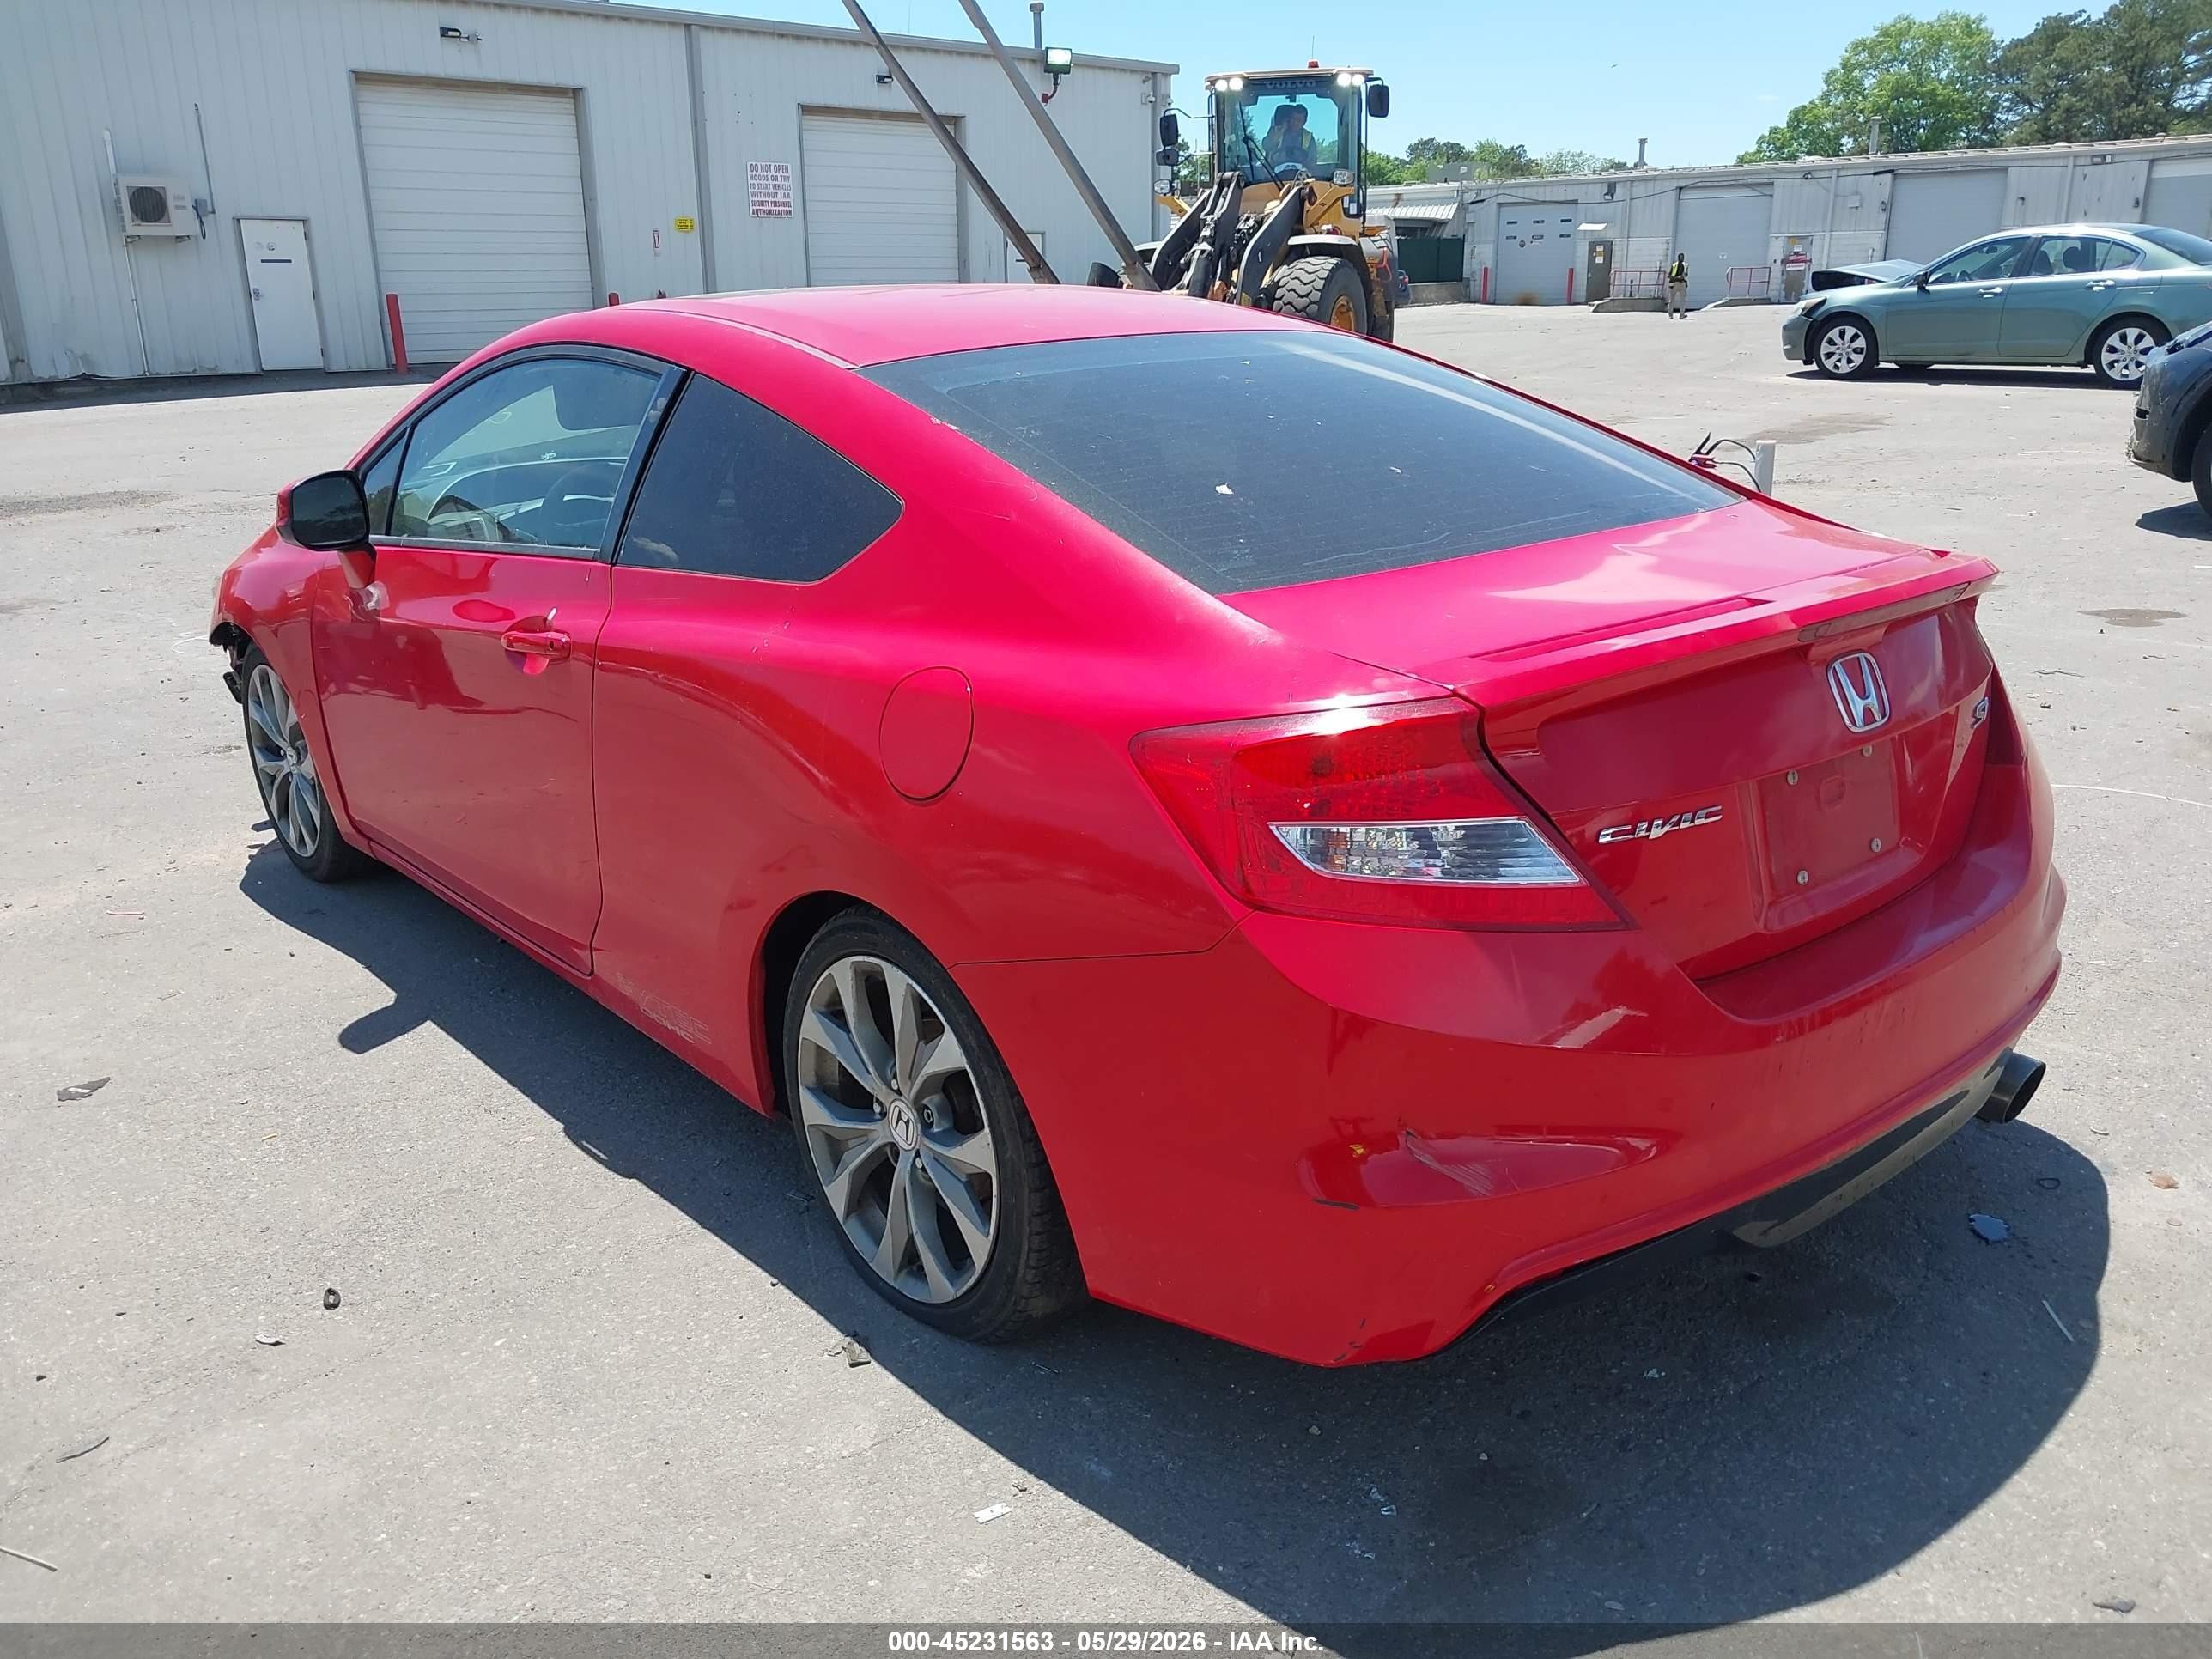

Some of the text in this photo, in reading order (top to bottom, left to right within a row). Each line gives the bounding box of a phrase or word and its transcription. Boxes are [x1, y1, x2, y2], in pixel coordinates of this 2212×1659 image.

[750, 163, 789, 173] DO NOT OPEN
[780, 174, 790, 183] TRY
[771, 183, 792, 191] VEHICLES
[751, 208, 793, 216] AUTHORIZATION
[1599, 805, 1723, 844] CIVIC
